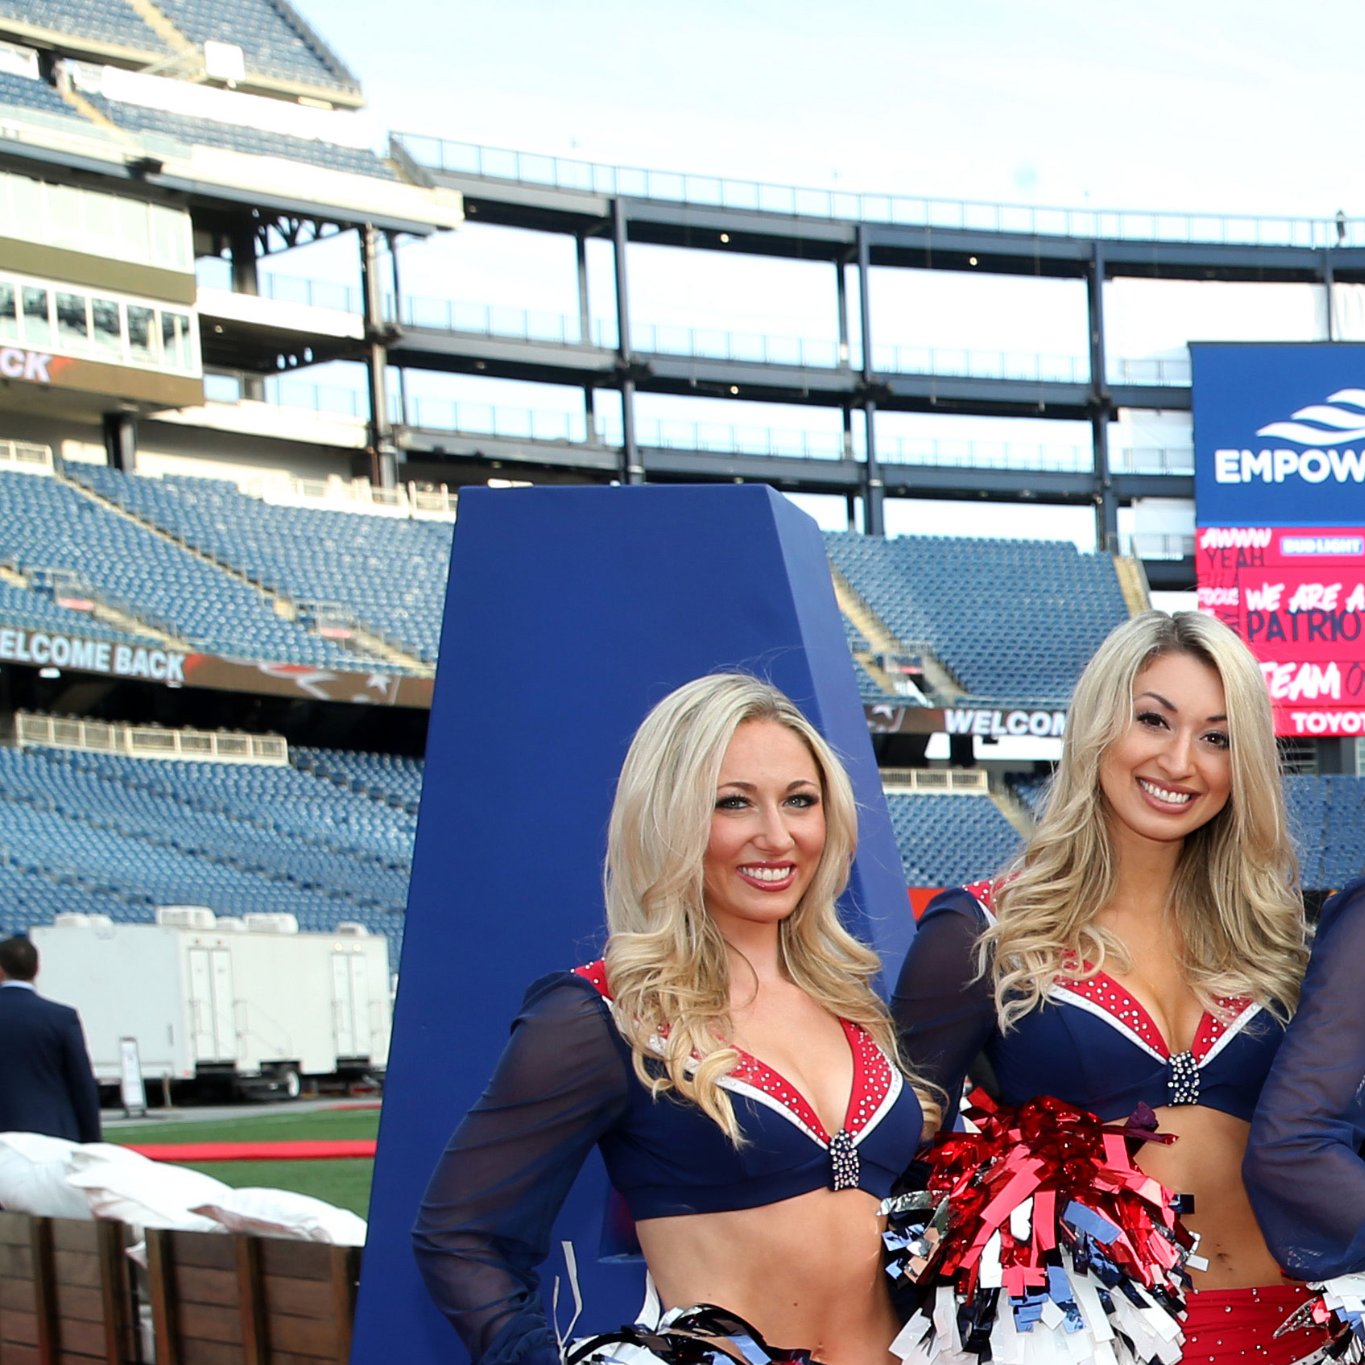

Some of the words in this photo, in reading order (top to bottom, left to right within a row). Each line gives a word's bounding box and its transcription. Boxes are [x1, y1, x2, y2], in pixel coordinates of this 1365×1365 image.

[1205, 546, 1265, 568] YEAH
[1282, 538, 1316, 554] BUD
[1317, 538, 1362, 554] LIGHT
[1245, 582, 1286, 612] WE
[1288, 583, 1342, 613] ARE
[0, 627, 112, 672] ELCOME
[114, 643, 186, 683] BACK
[1259, 661, 1341, 701] TEAM
